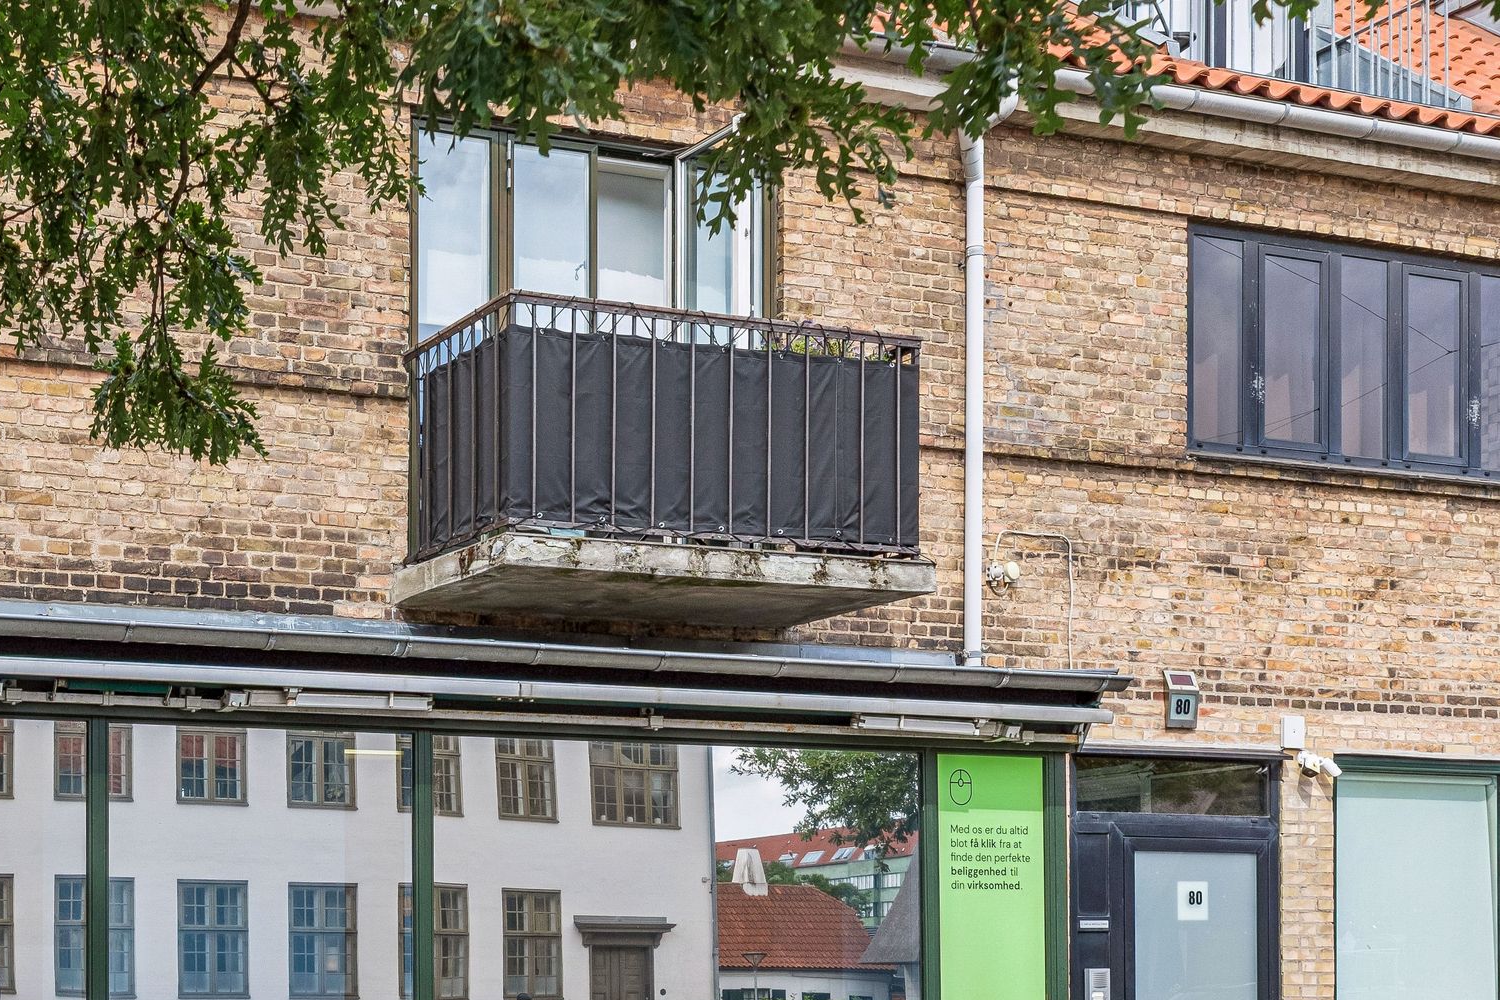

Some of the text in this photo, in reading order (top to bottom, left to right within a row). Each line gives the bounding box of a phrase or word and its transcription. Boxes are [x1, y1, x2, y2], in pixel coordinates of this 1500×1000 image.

[1175, 698, 1191, 715] 80
[950, 824, 1029, 836] Med os er du altid
[950, 838, 1023, 849] blot få klik fra at
[950, 851, 1031, 865] finde den perfekte
[950, 866, 1018, 878] beliggenhed til
[950, 879, 1023, 890] din virksomhed.
[1188, 890, 1203, 905] 80
